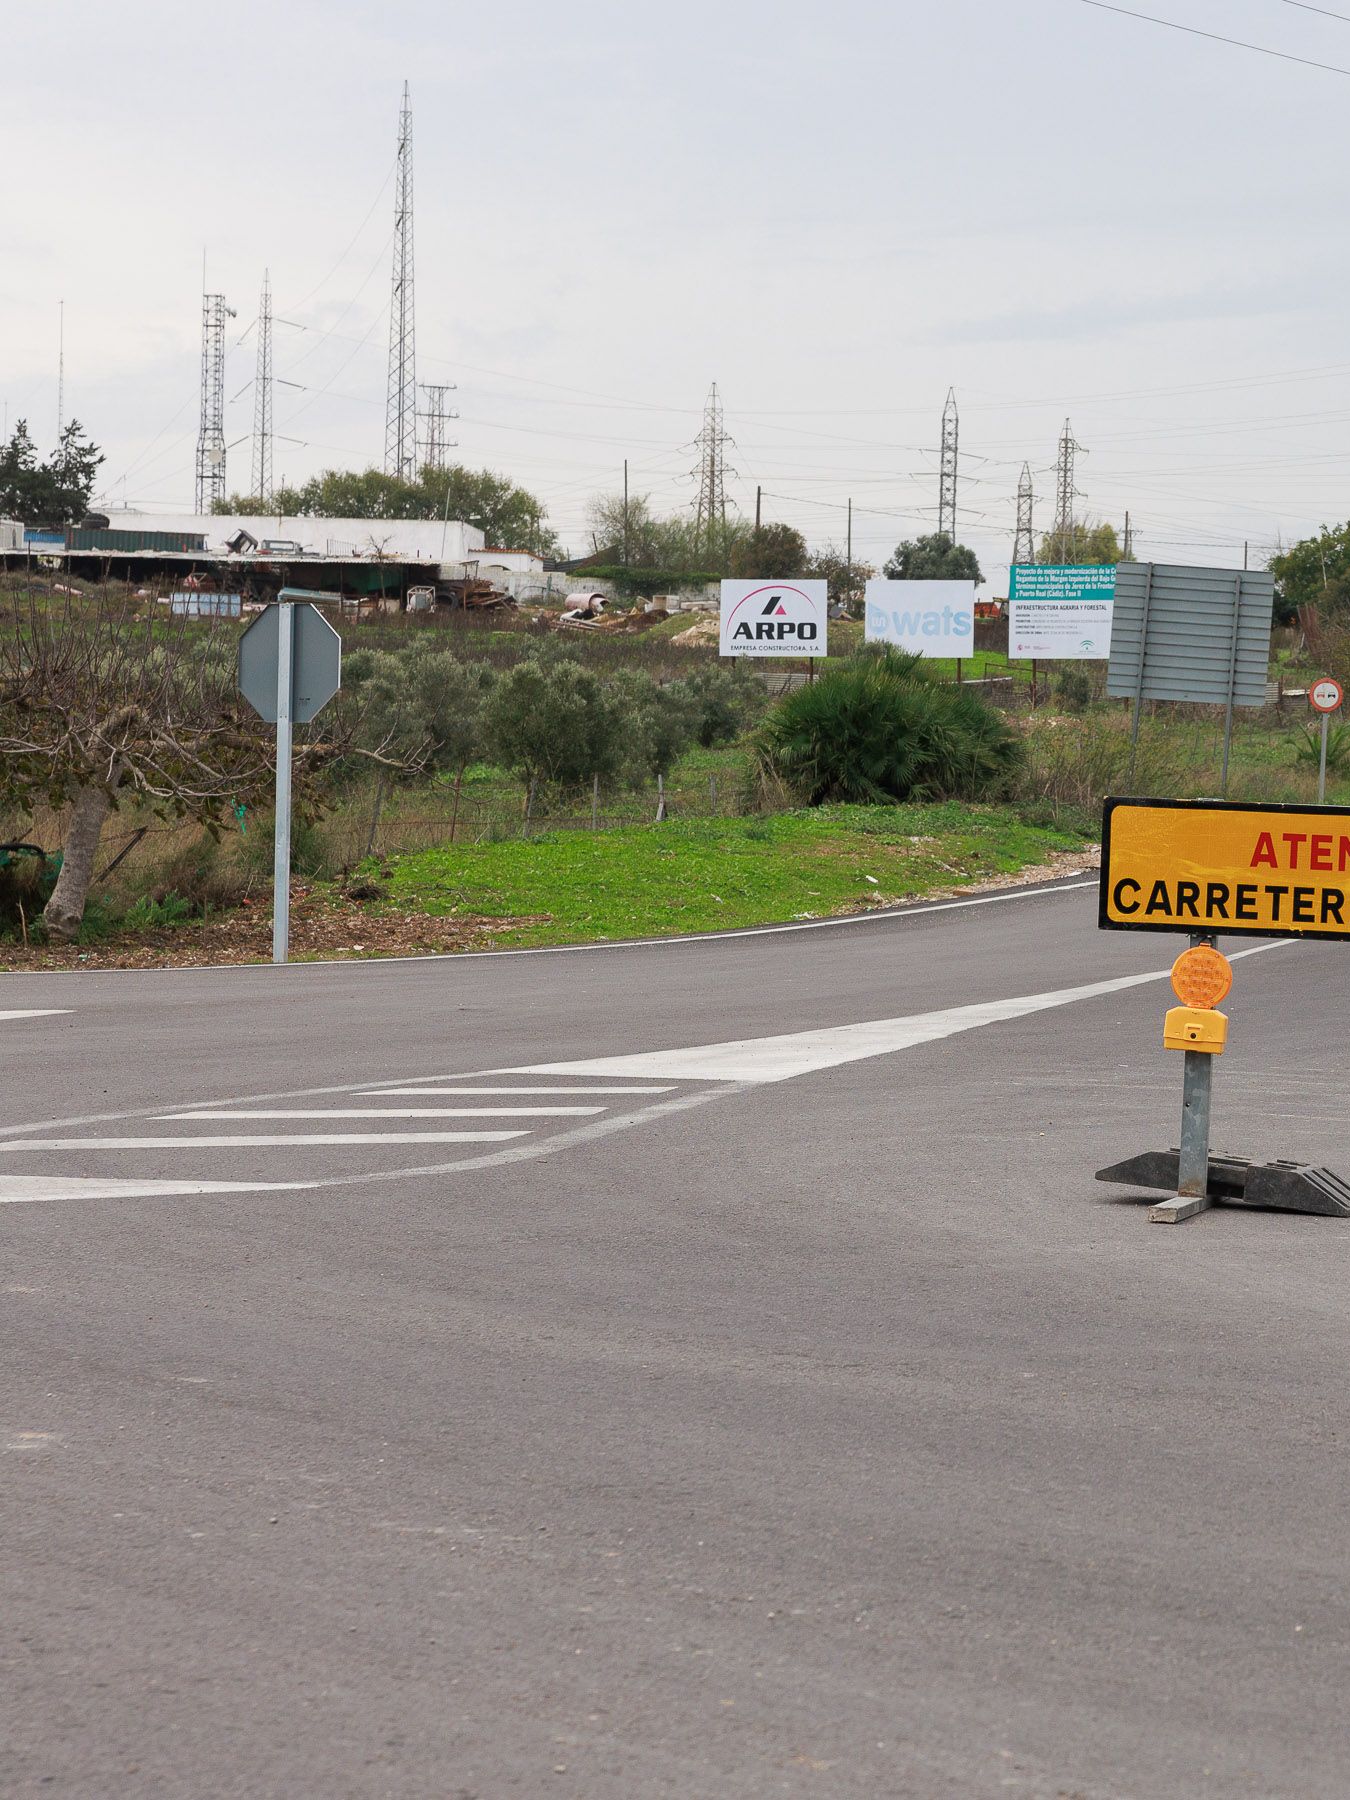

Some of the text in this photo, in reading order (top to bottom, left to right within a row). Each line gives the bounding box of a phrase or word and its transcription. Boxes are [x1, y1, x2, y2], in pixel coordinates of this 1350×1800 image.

[1015, 568, 1036, 577] Proyecto
[1044, 568, 1060, 577] mejora
[1050, 575, 1068, 583] Margen
[1068, 575, 1090, 583] Izquierda
[1099, 575, 1110, 583] Bajo
[1036, 582, 1064, 590] municipales
[732, 622, 817, 640] ARPO
